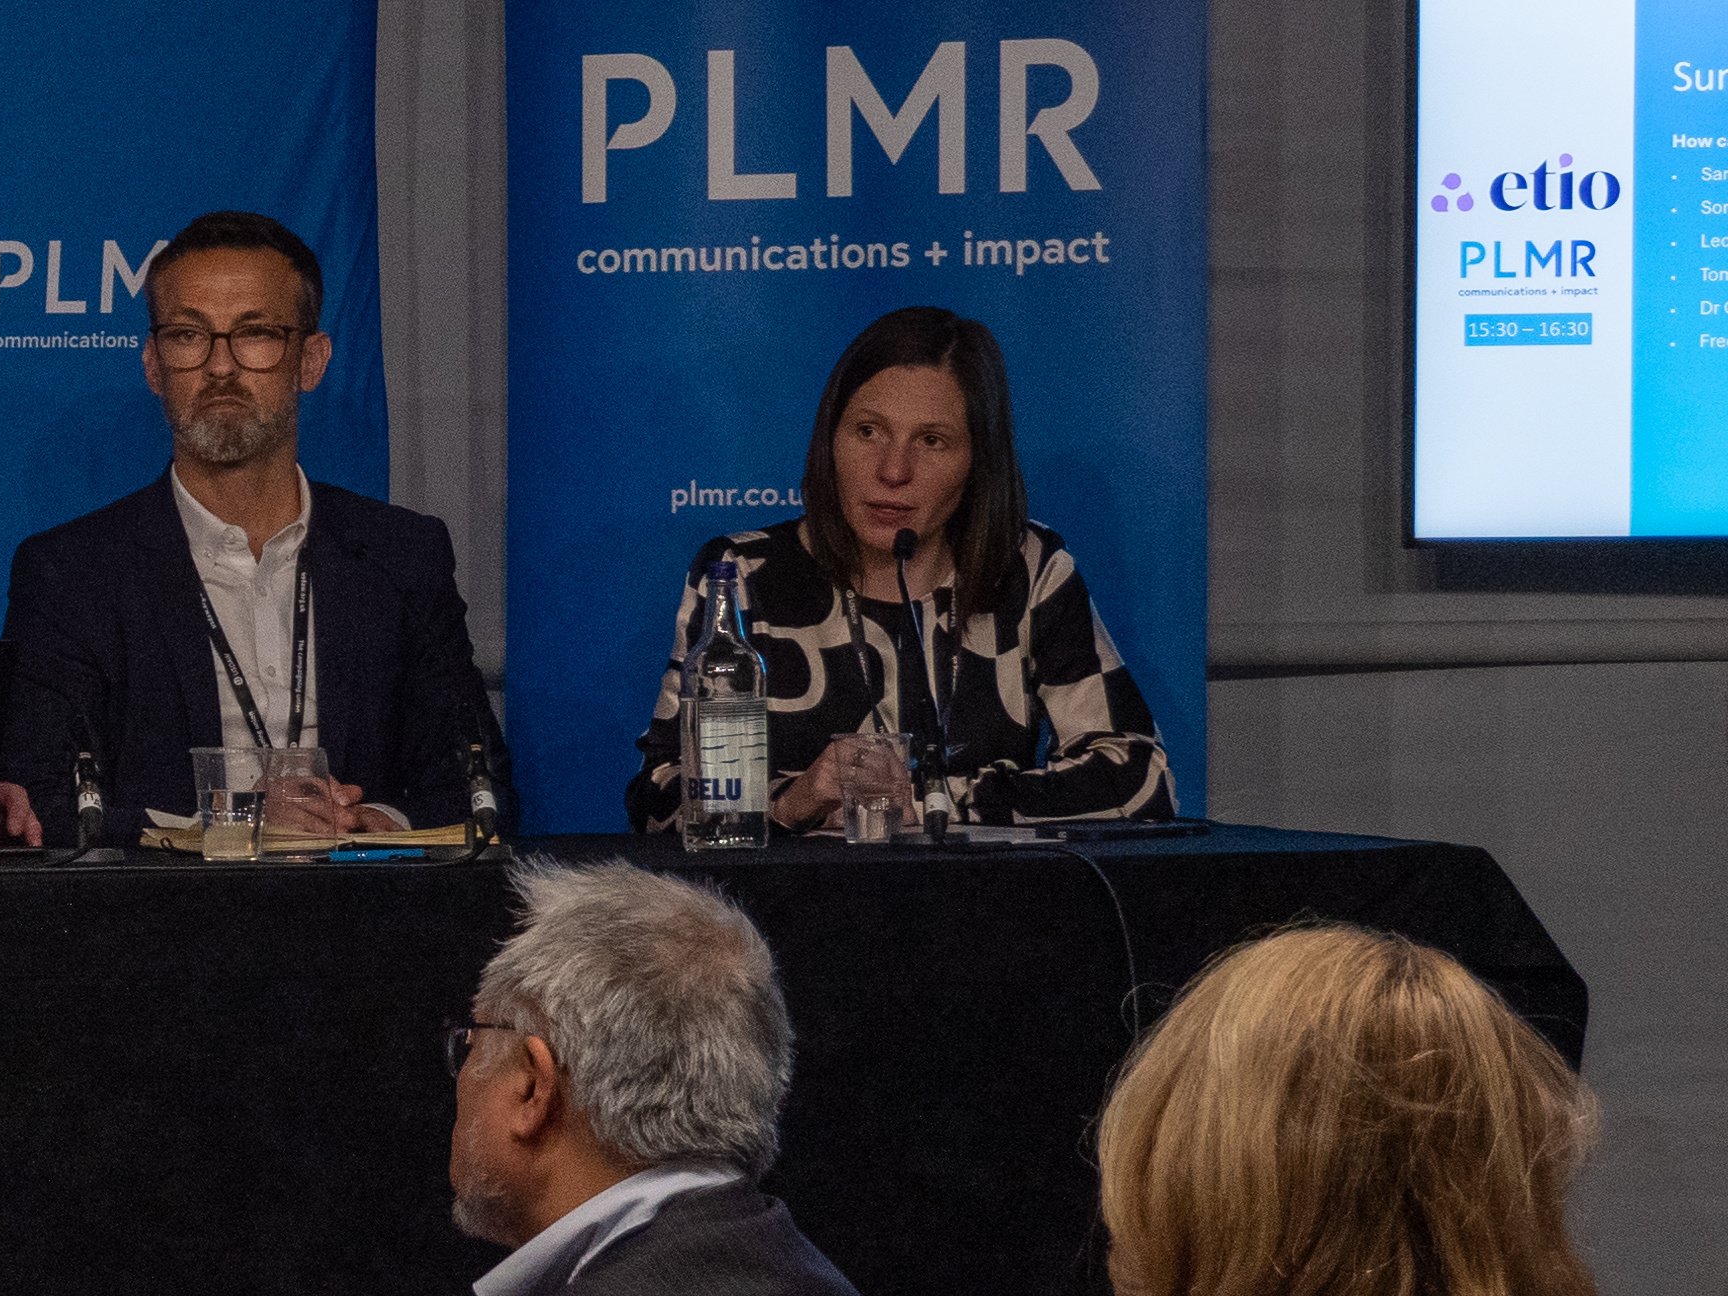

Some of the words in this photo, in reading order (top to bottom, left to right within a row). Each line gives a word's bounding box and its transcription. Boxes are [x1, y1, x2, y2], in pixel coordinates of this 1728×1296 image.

[581, 37, 1103, 204] PLMR
[1672, 133, 1713, 148] How
[1489, 152, 1621, 212] etio
[577, 234, 910, 274] communications
[924, 241, 948, 266] +
[964, 230, 1110, 277] impact
[1459, 239, 1597, 279] PLMR
[1458, 286, 1547, 297] communications
[1560, 286, 1598, 298] impact
[1699, 300, 1721, 315] Dr
[1468, 322, 1519, 338] 15:30
[1539, 321, 1589, 337] 16:30
[670, 478, 803, 514] plmr.co.u
[687, 777, 742, 801] BELU
